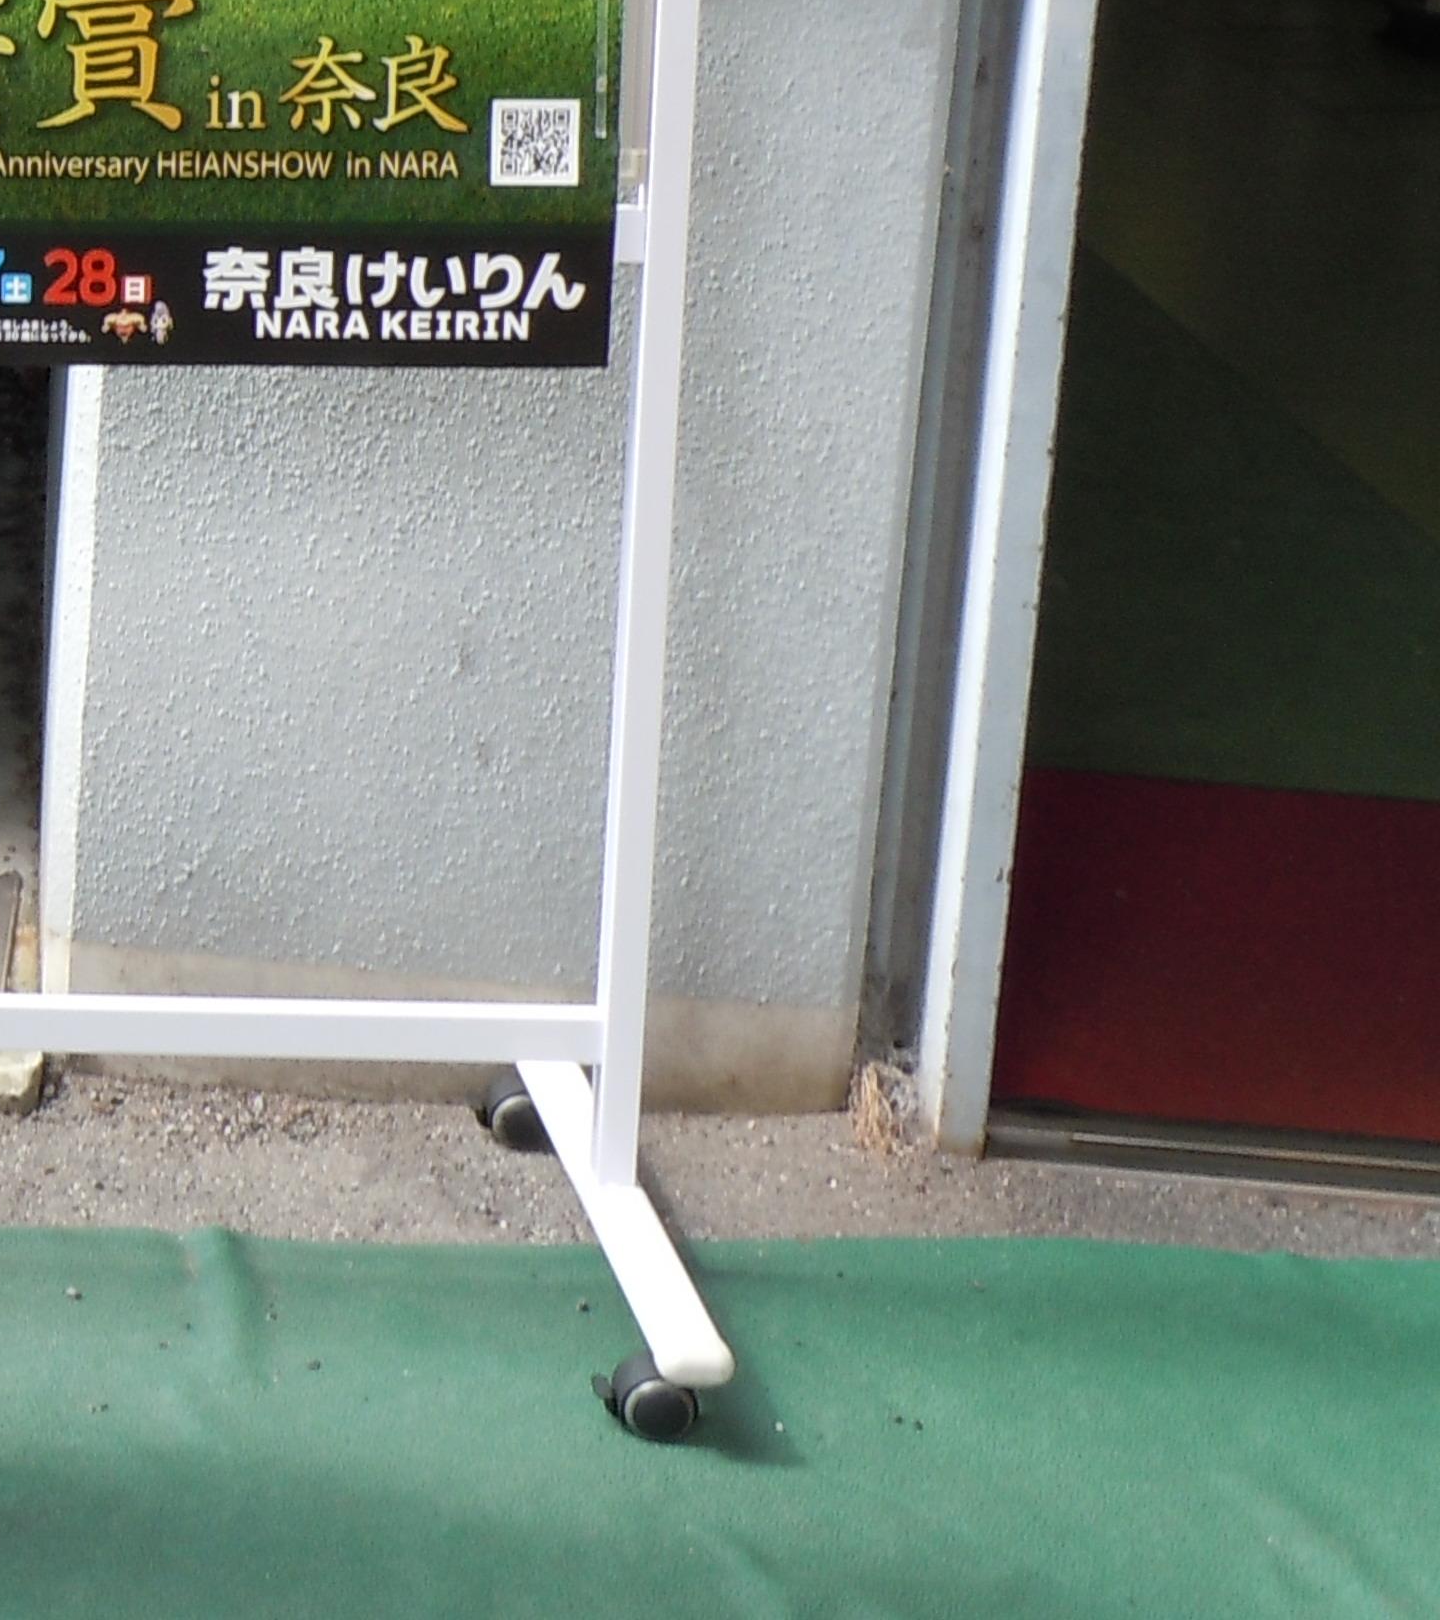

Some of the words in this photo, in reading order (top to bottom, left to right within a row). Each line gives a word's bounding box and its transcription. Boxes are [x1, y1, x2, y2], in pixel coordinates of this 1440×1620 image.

[205, 75, 266, 130] in
[278, 35, 470, 134] 奈良
[156, 151, 334, 178] HEIANSHOW
[347, 152, 370, 178] in
[379, 151, 459, 178] NARA
[42, 247, 117, 305] 28
[202, 246, 587, 311] 奈良けいりん
[255, 310, 370, 340] NARA
[380, 309, 530, 341] KEIRIN
